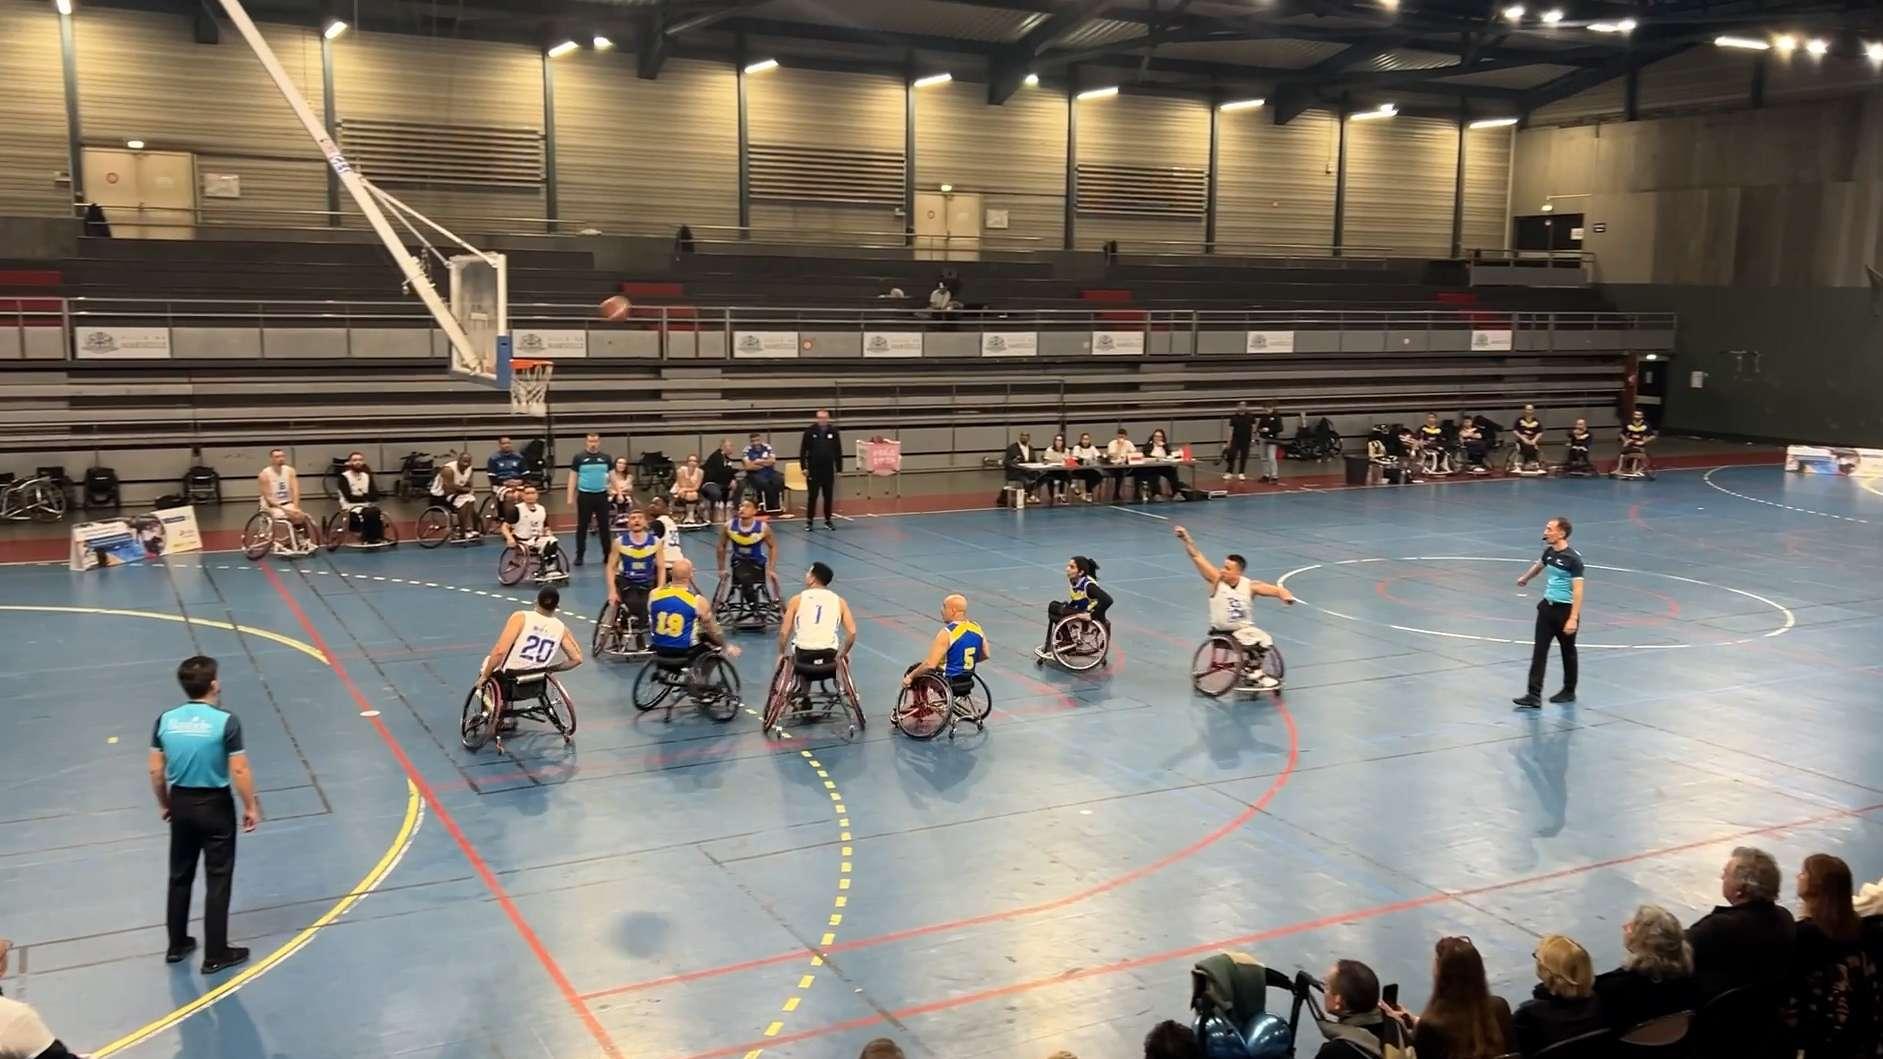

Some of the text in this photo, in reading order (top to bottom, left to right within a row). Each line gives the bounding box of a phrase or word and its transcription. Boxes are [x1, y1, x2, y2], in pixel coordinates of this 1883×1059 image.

[815, 604, 823, 624] 1
[519, 635, 555, 662] 20
[963, 646, 976, 670] 5
